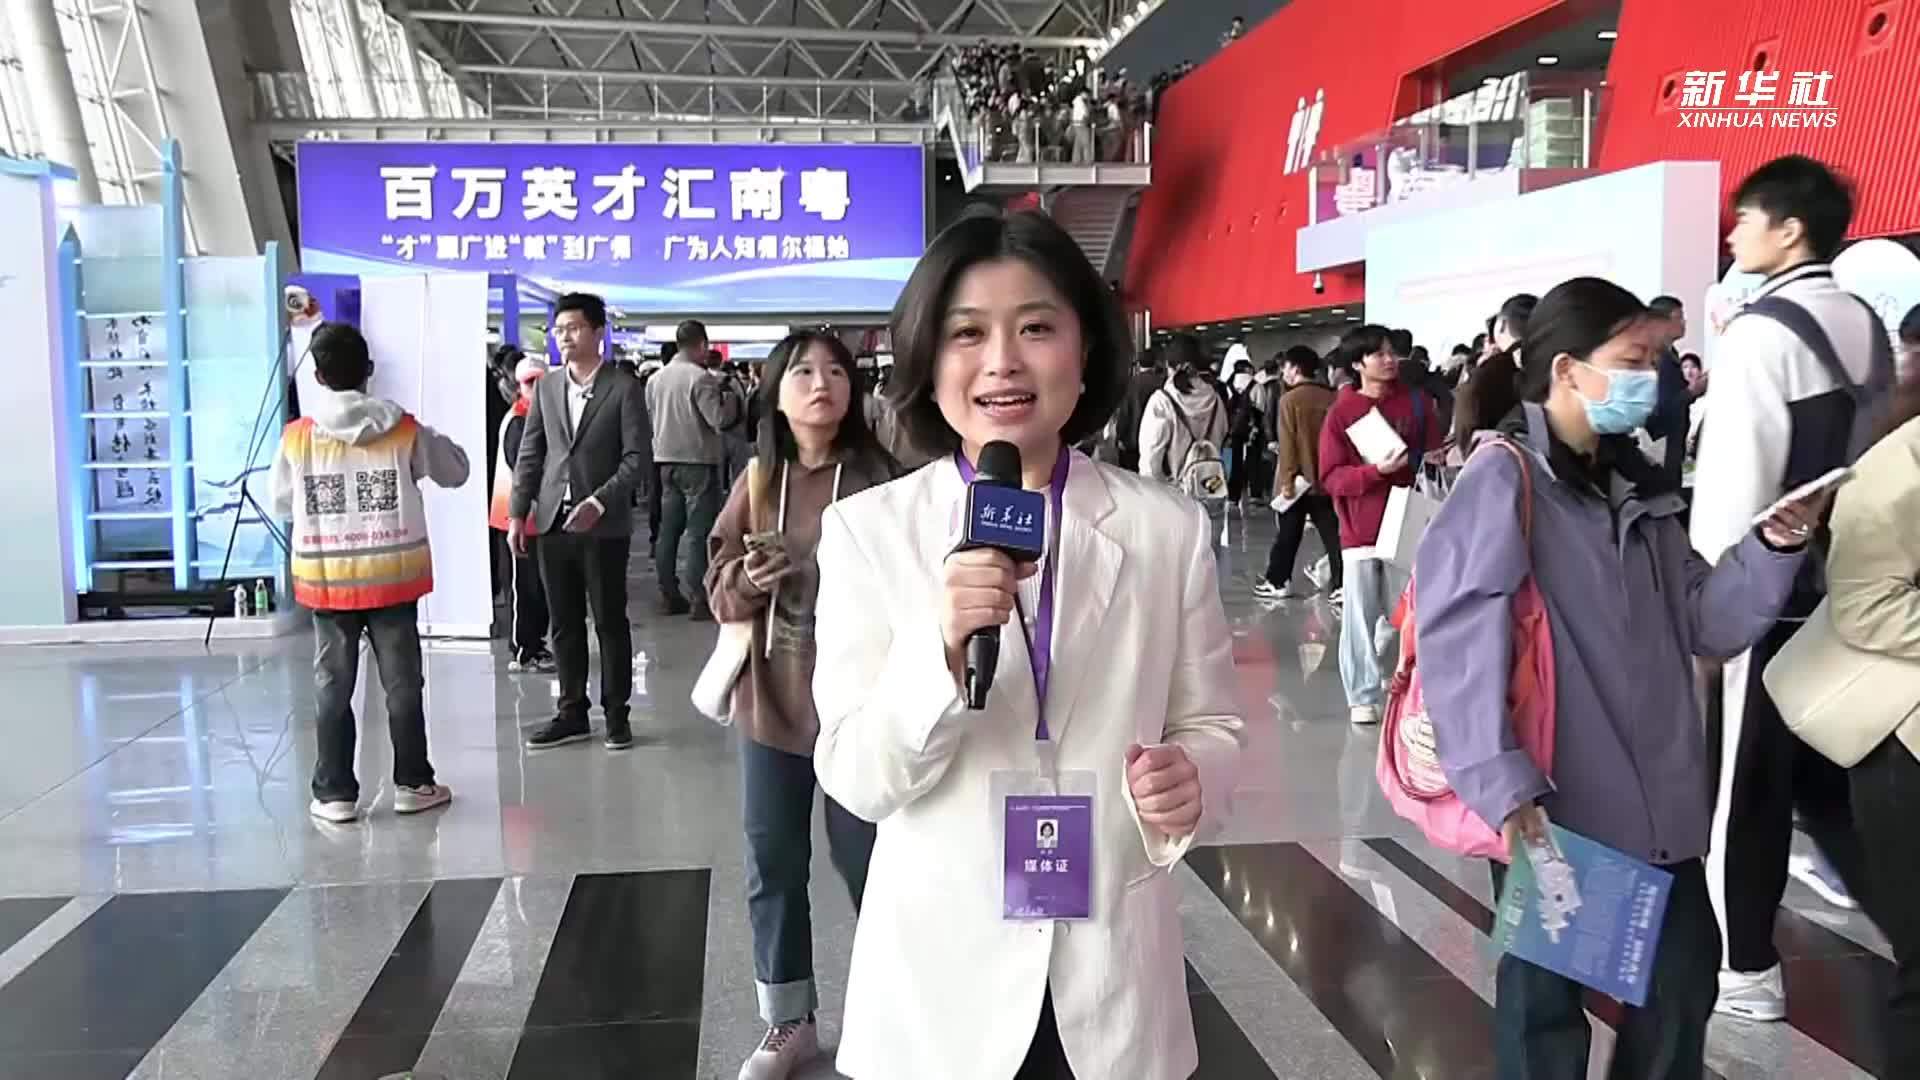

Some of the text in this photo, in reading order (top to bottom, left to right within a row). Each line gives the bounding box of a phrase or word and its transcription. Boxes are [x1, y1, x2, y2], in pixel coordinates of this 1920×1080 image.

[380, 165, 850, 221] 百万英才汇南粤
[1024, 859, 1069, 873] 媒体证
